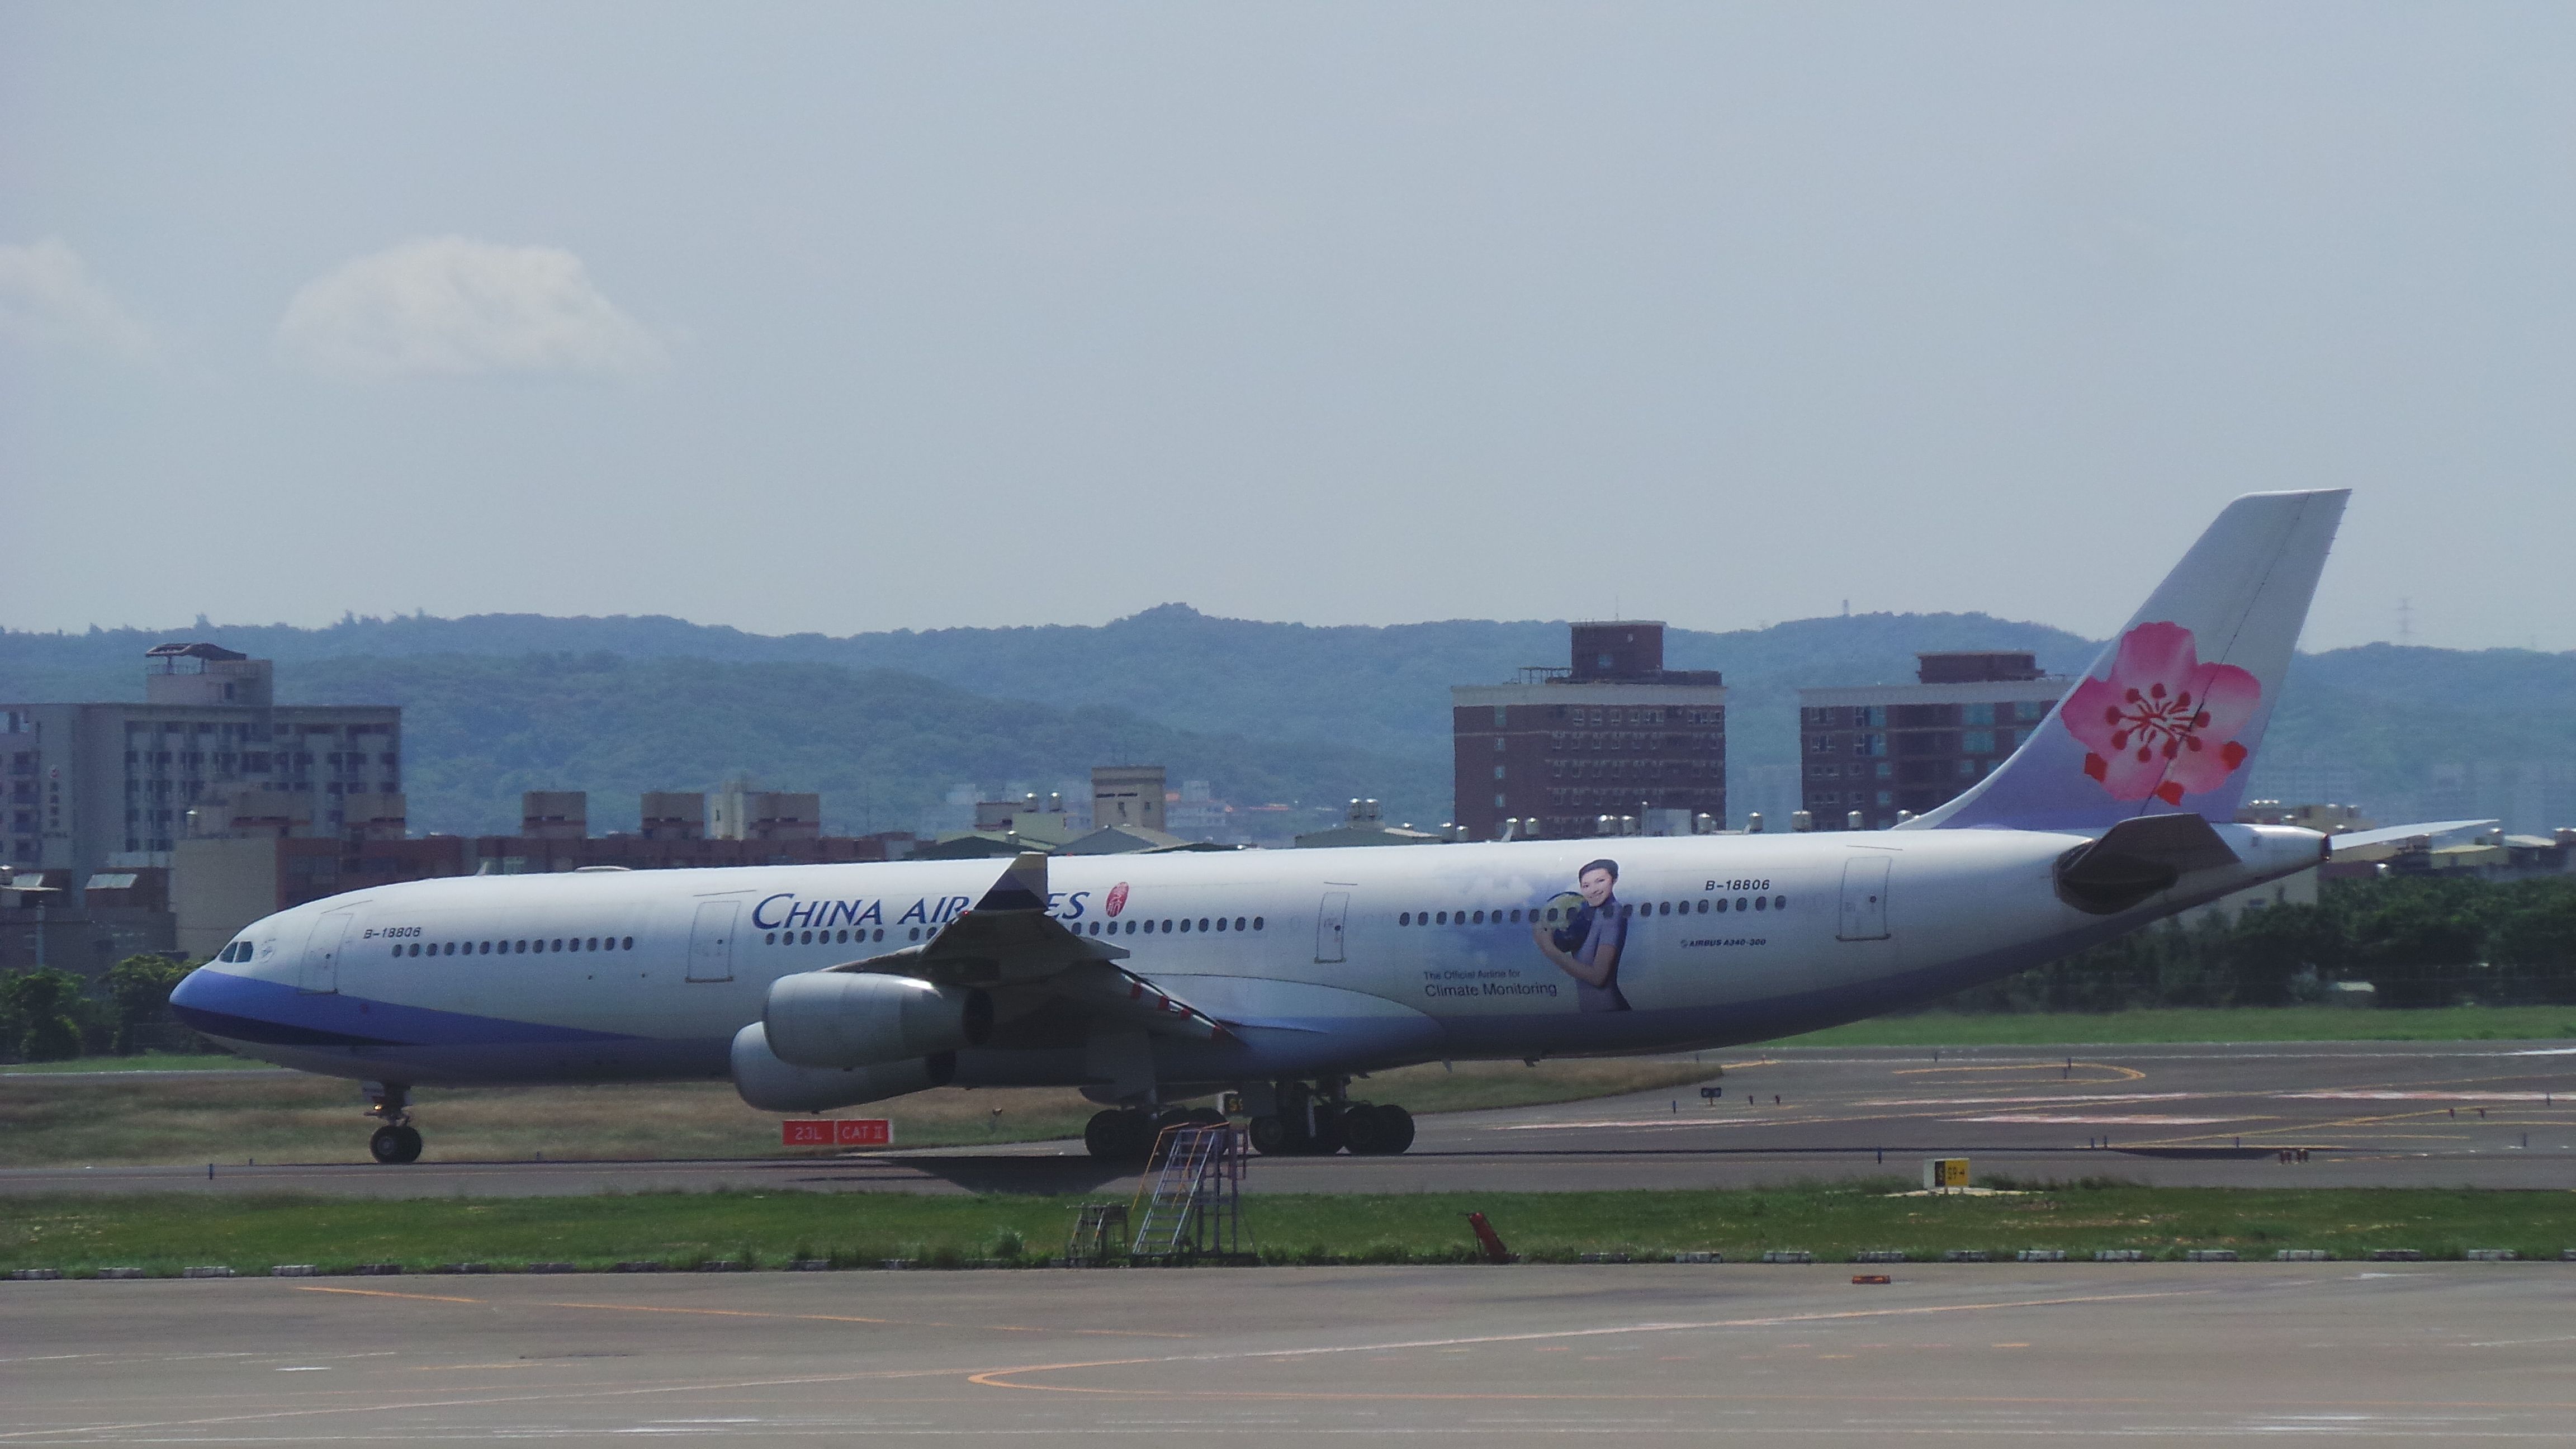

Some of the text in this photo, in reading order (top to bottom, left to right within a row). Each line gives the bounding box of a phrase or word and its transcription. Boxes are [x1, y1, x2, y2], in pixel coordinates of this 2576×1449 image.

[1705, 879, 1770, 891] B-18806
[752, 893, 883, 930] CHINA
[897, 892, 1091, 925] AIRES
[363, 927, 422, 939] B-18806
[1424, 971, 1441, 979] The
[1444, 970, 1475, 979] Official
[1509, 969, 1521, 978] for
[1426, 982, 1557, 997] Climate Monitoring
[842, 1126, 868, 1139] CAT
